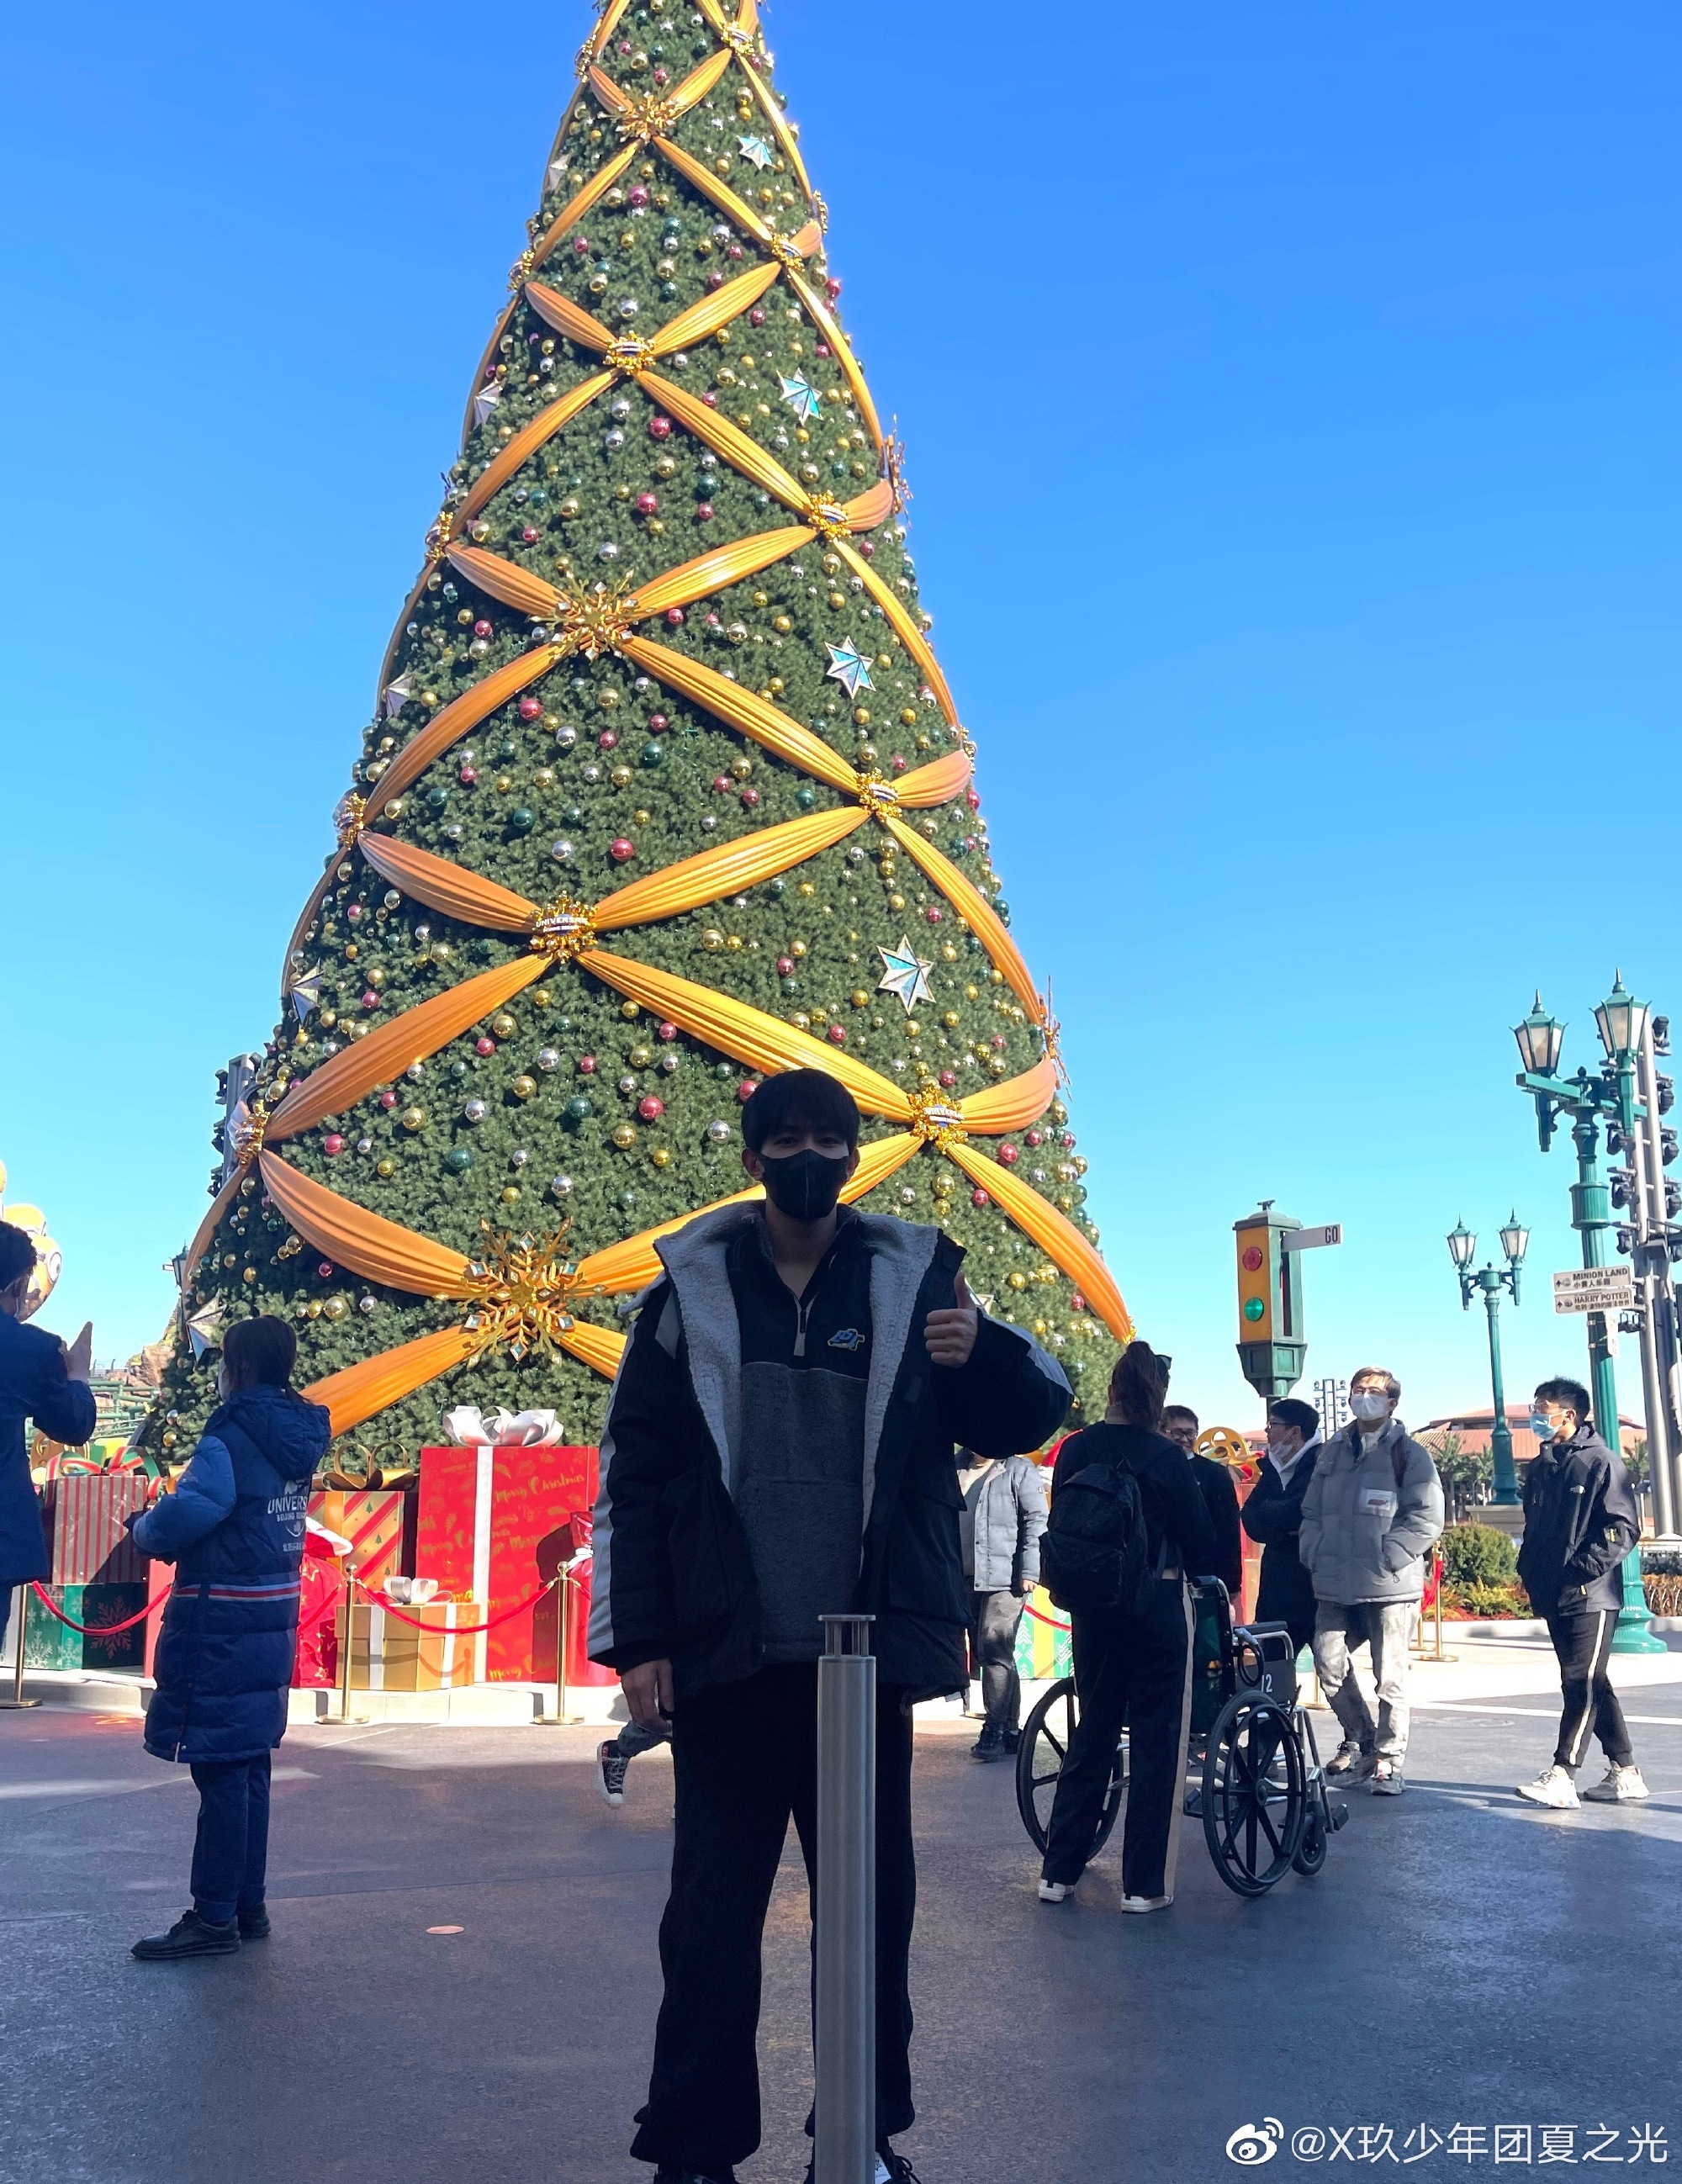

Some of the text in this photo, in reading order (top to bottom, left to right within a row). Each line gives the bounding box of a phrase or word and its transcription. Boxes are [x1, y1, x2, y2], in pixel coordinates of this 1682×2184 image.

[1325, 1226, 1337, 1244] GO
[1573, 1267, 1628, 1280] MINION LAND
[1574, 1292, 1629, 1304] HARRY POTTER
[528, 1472, 584, 1495] Christmas
[1261, 1674, 1272, 1693] 12
